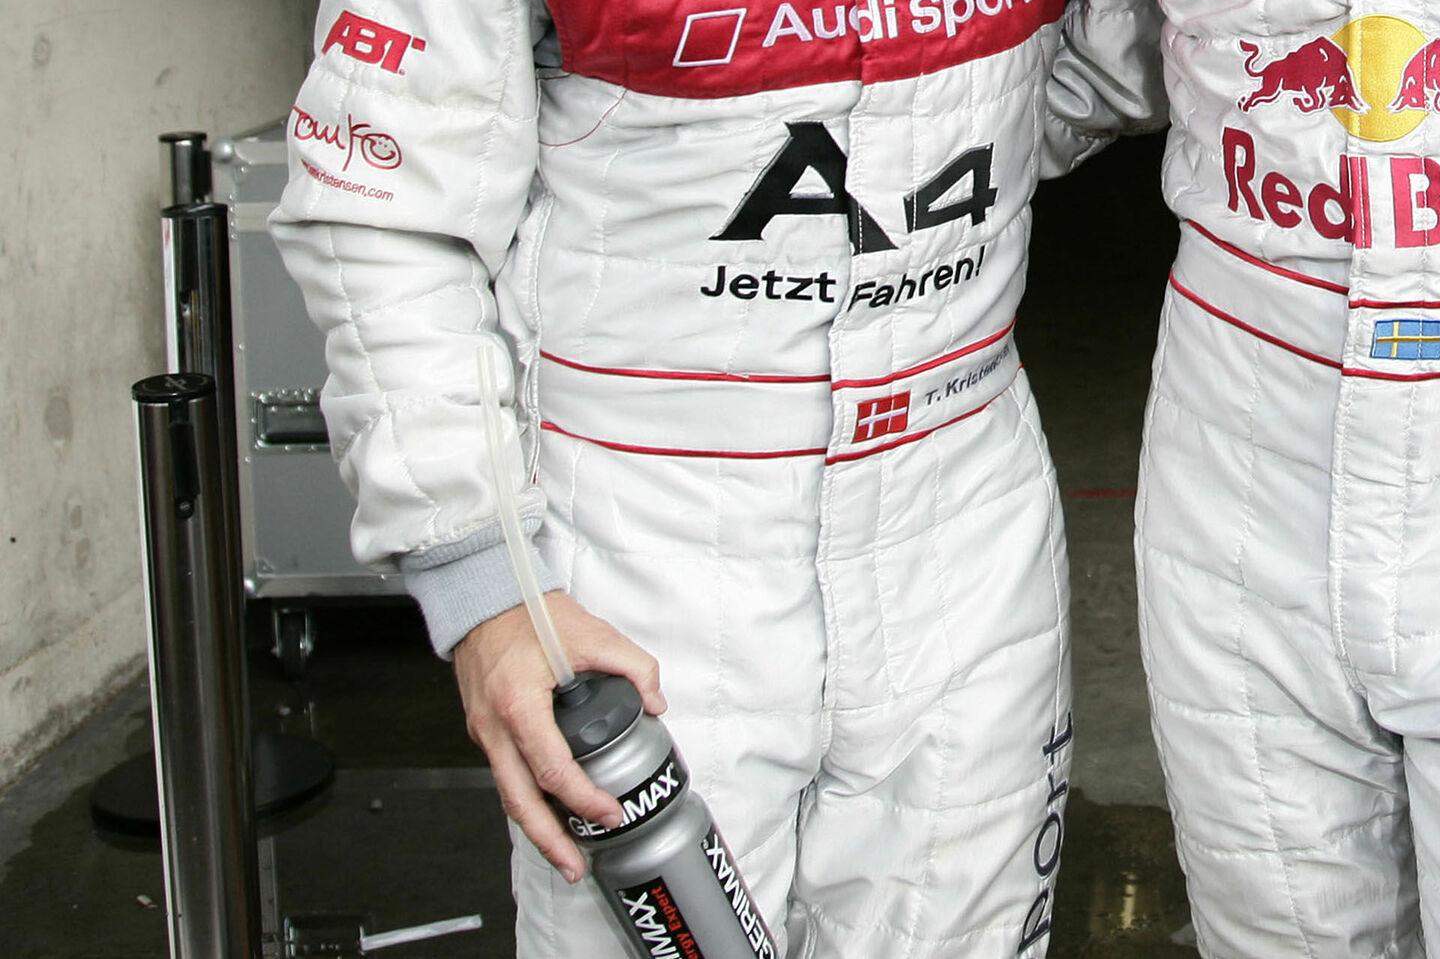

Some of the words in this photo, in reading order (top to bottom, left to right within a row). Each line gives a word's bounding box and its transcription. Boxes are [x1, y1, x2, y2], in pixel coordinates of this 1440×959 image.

[321, 9, 413, 75] ABT
[708, 121, 998, 256] A4
[1222, 126, 1372, 249] Red
[700, 265, 837, 303] Jetzt
[847, 245, 986, 313] Fahren!
[924, 389, 941, 406] T.
[568, 765, 680, 837] GEIMAX
[650, 885, 683, 932] Expert
